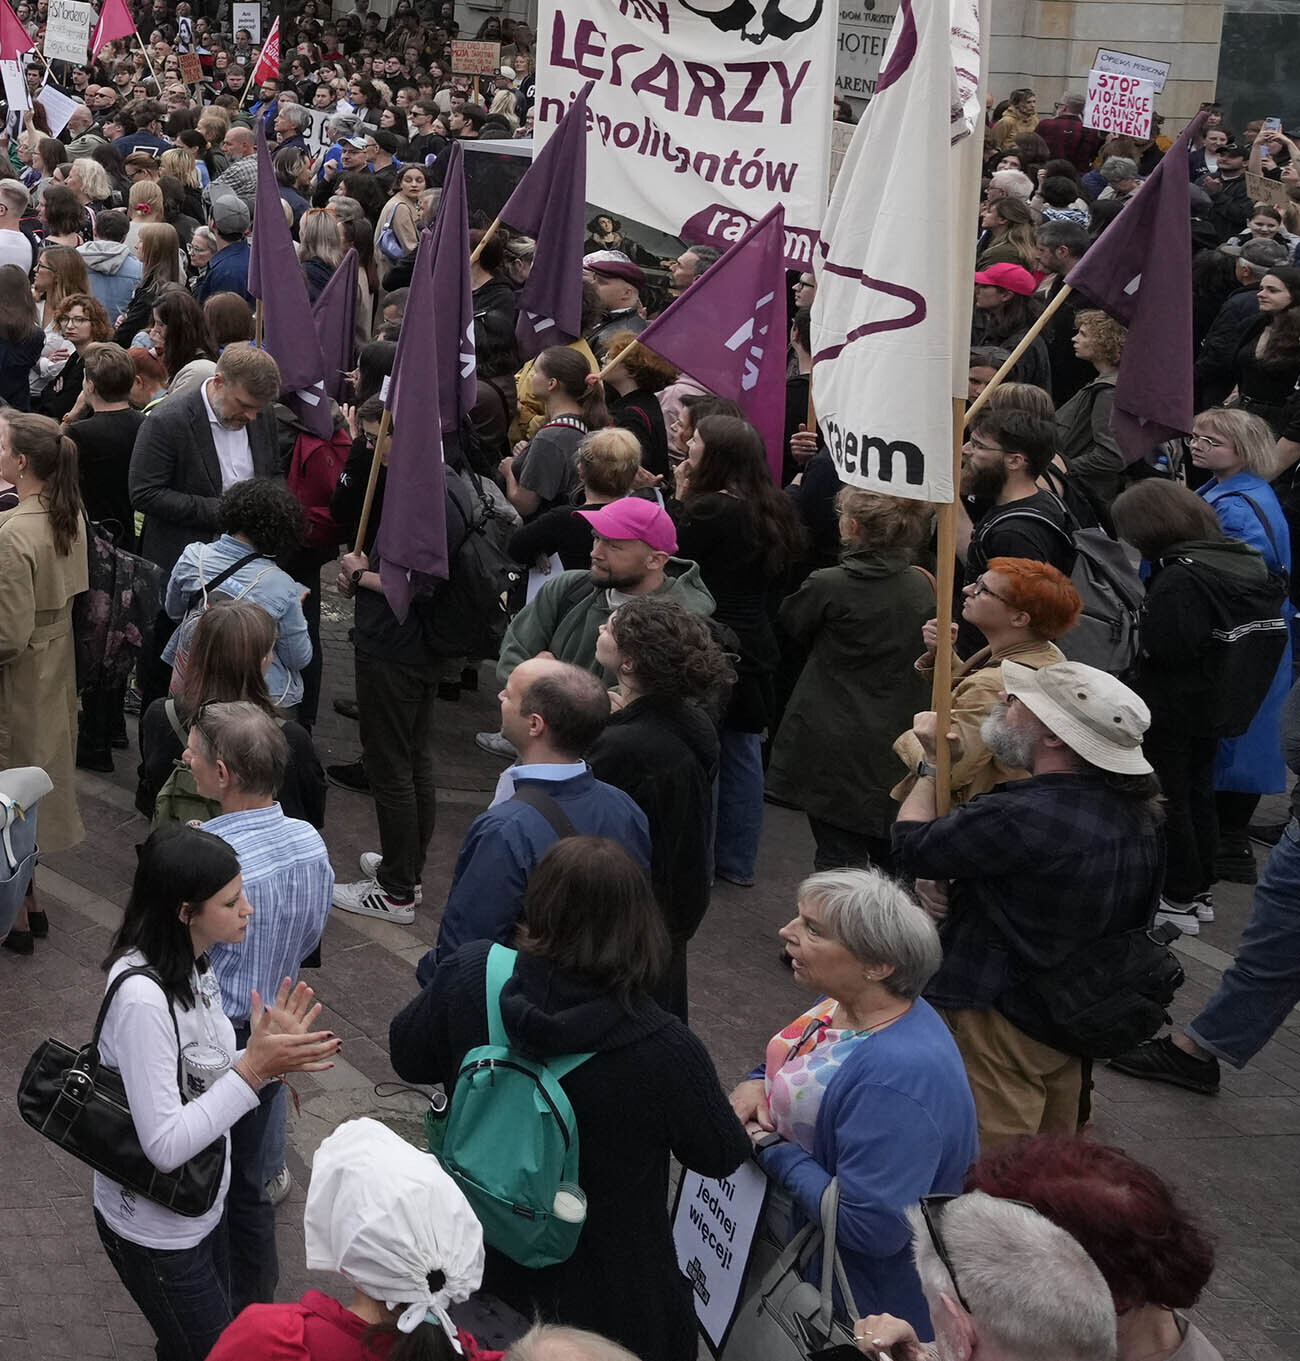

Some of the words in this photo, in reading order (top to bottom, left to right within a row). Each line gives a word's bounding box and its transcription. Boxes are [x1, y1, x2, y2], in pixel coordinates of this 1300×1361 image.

[836, 76, 878, 94] AREN
[1097, 74, 1140, 94] STOP
[1088, 88, 1150, 114] VIOLENCE
[1092, 104, 1142, 122] AGAINST
[1091, 114, 1150, 137] WOMEN!
[707, 207, 813, 264] ram
[827, 420, 924, 486] raem
[718, 1178, 736, 1202] ni
[696, 1178, 736, 1242] jednej
[689, 1204, 733, 1270] więcej!
